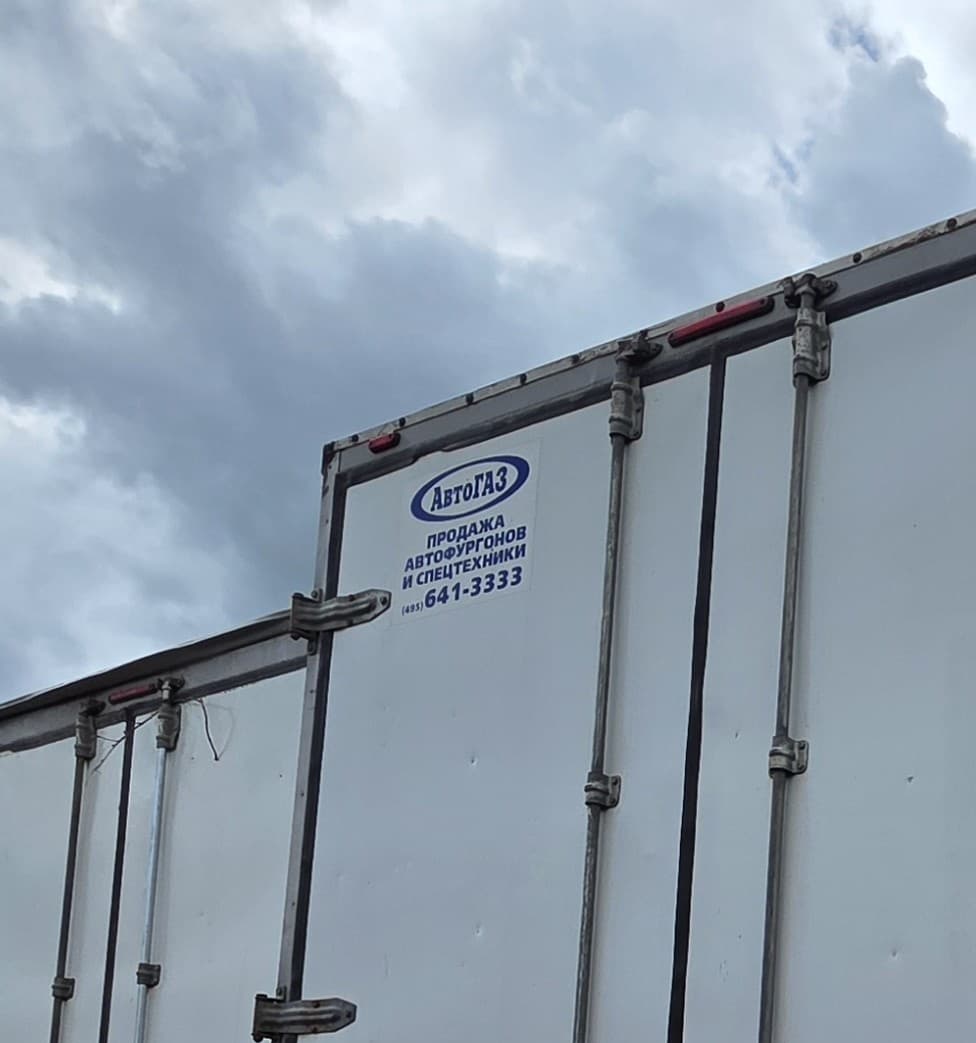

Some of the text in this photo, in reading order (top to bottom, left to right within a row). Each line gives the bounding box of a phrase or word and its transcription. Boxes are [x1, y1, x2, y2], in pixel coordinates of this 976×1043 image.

[405, 526, 527, 572] АВТОФУРГОНОВ
[427, 515, 505, 549] ПРОДАЖА
[403, 544, 526, 590] И СПЕЦТЕХНИКИ
[402, 566, 522, 616] (495) 641-3333
